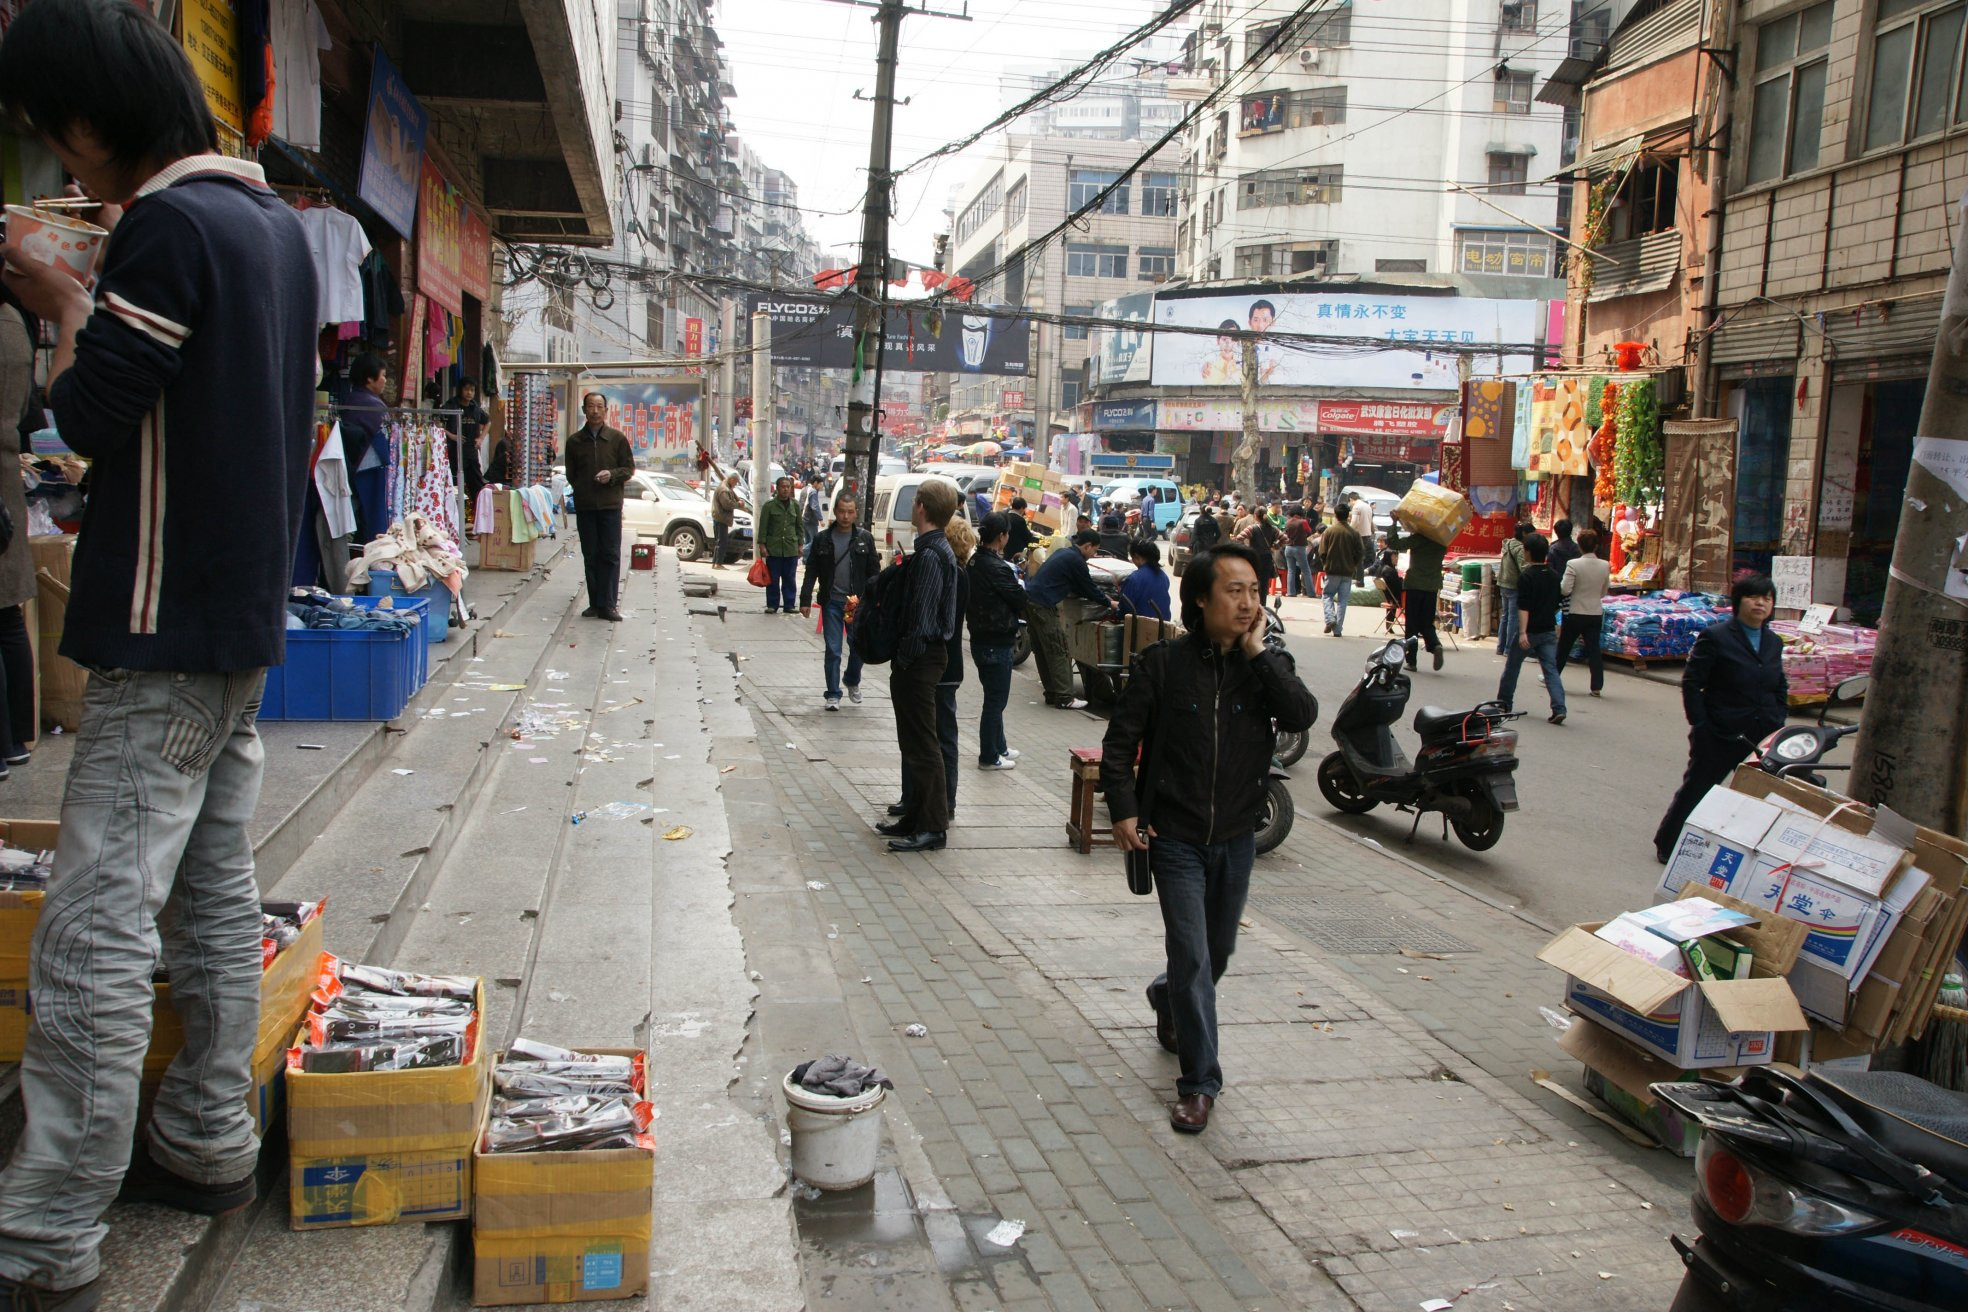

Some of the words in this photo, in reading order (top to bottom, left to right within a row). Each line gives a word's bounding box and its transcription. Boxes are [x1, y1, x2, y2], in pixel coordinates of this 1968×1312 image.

[1317, 304, 1407, 320] 真情永不变
[1321, 411, 1357, 421] Colgate
[1714, 851, 1735, 878] 天堂
